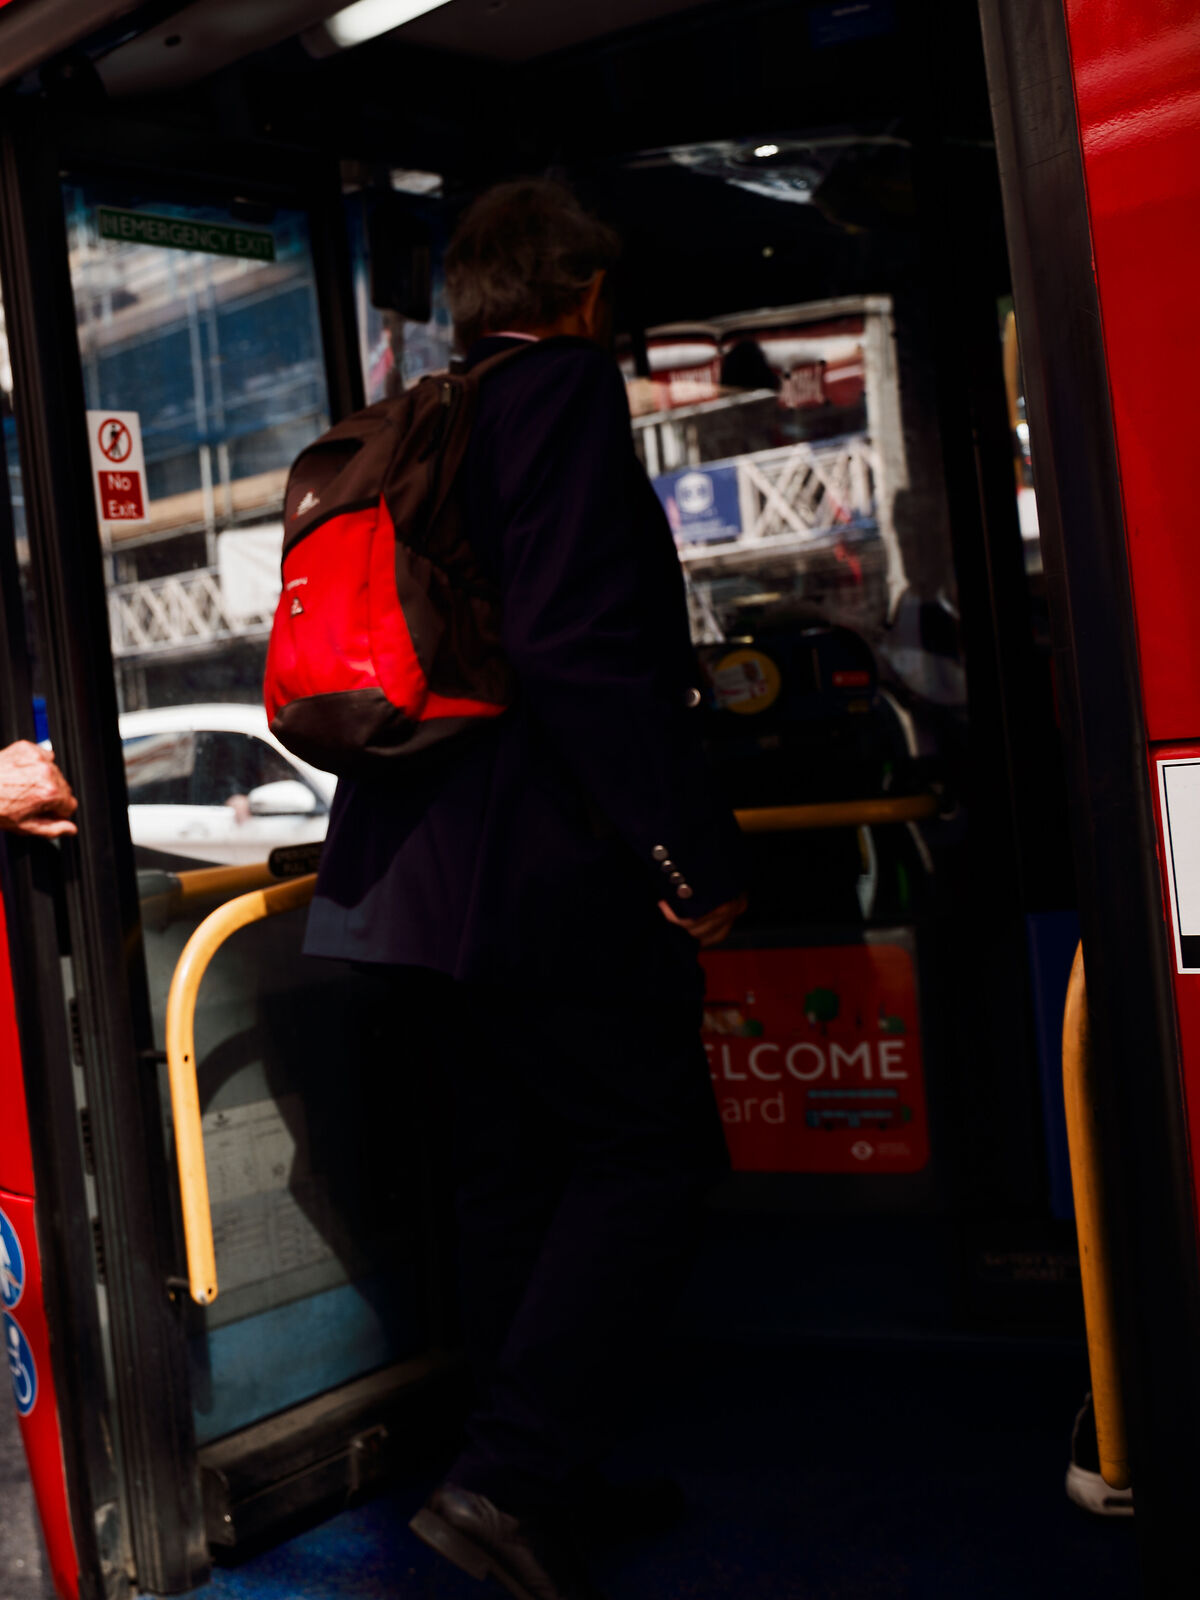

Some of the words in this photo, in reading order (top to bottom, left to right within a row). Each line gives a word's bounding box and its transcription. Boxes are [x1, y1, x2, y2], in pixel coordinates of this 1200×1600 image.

[107, 472, 132, 492] No
[108, 500, 139, 518] Exit
[704, 1039, 909, 1081] LCOME
[721, 1090, 786, 1125] ard
